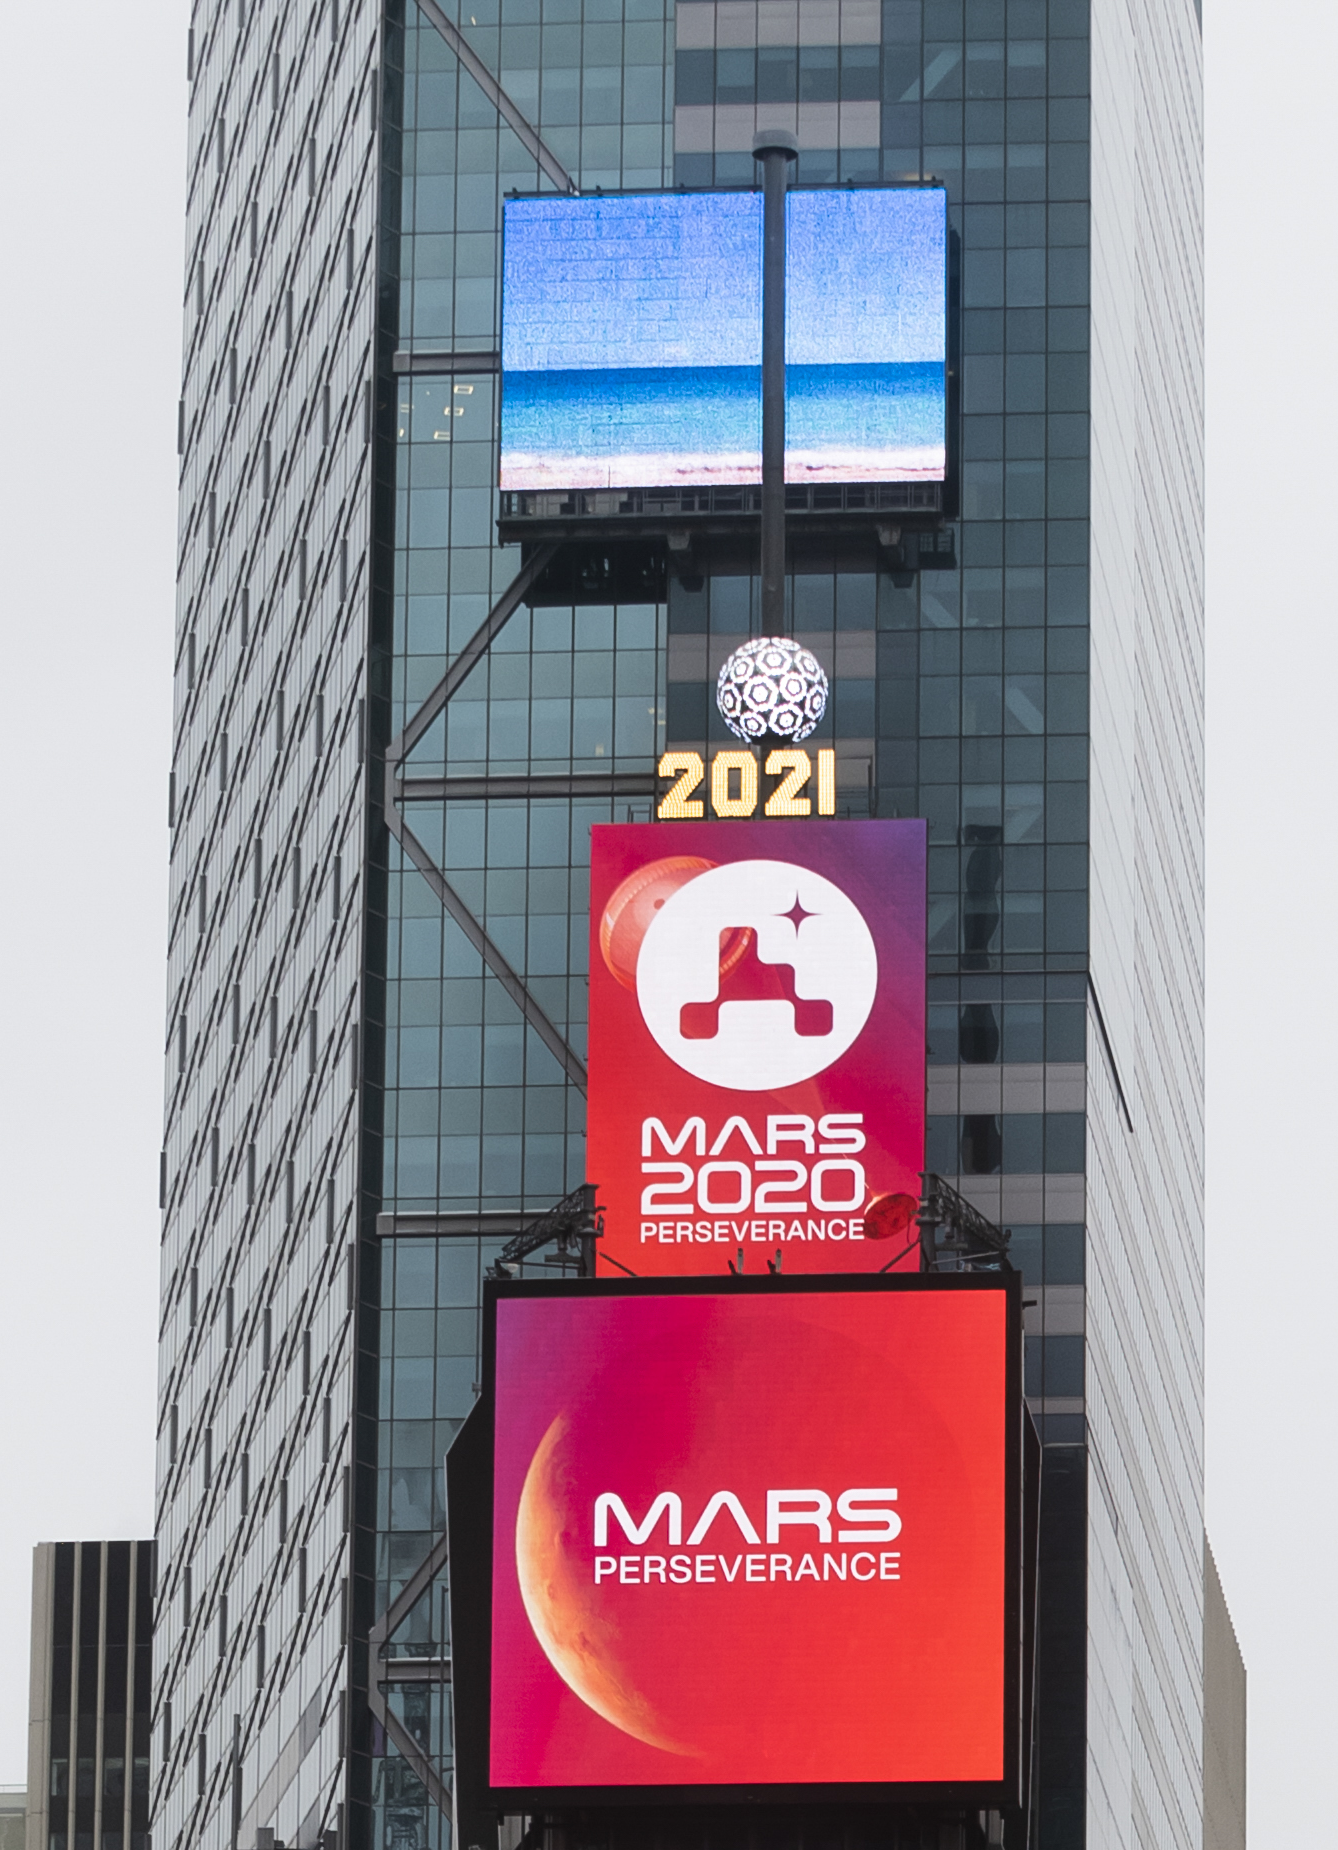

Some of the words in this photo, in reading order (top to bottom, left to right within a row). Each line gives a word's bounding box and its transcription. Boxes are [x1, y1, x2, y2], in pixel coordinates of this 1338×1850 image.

[657, 750, 837, 819] 2021
[642, 1114, 866, 1156] MARS
[640, 1161, 866, 1214] 2020
[639, 1220, 865, 1243] PERSEVERANCE
[592, 1488, 902, 1544] MARS
[592, 1552, 902, 1584] PERSEVERANCE
